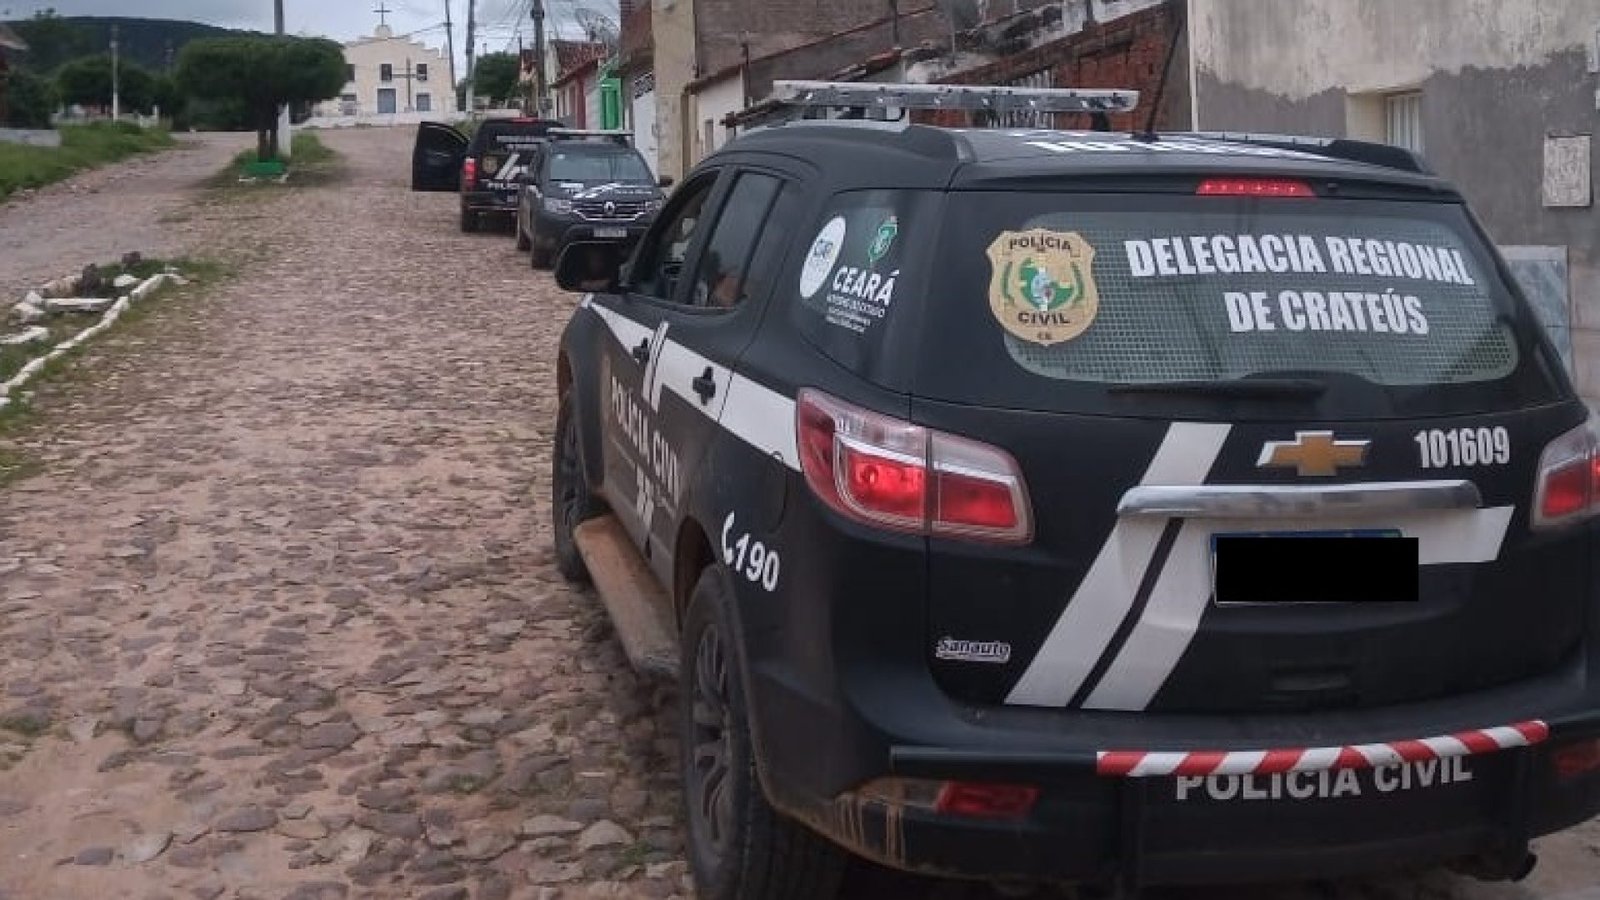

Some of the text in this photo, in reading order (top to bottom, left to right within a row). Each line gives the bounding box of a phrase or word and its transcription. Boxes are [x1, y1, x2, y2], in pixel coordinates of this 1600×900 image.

[1124, 235, 1475, 285] DELEGACIA REGIONAL
[832, 265, 900, 307] CEARÁ
[1018, 312, 1070, 325] CIVIL
[1224, 288, 1429, 334] DE CRATEÚS
[1414, 426, 1510, 468] 101609
[735, 533, 780, 592] 190
[1374, 755, 1473, 793] CIVIL
